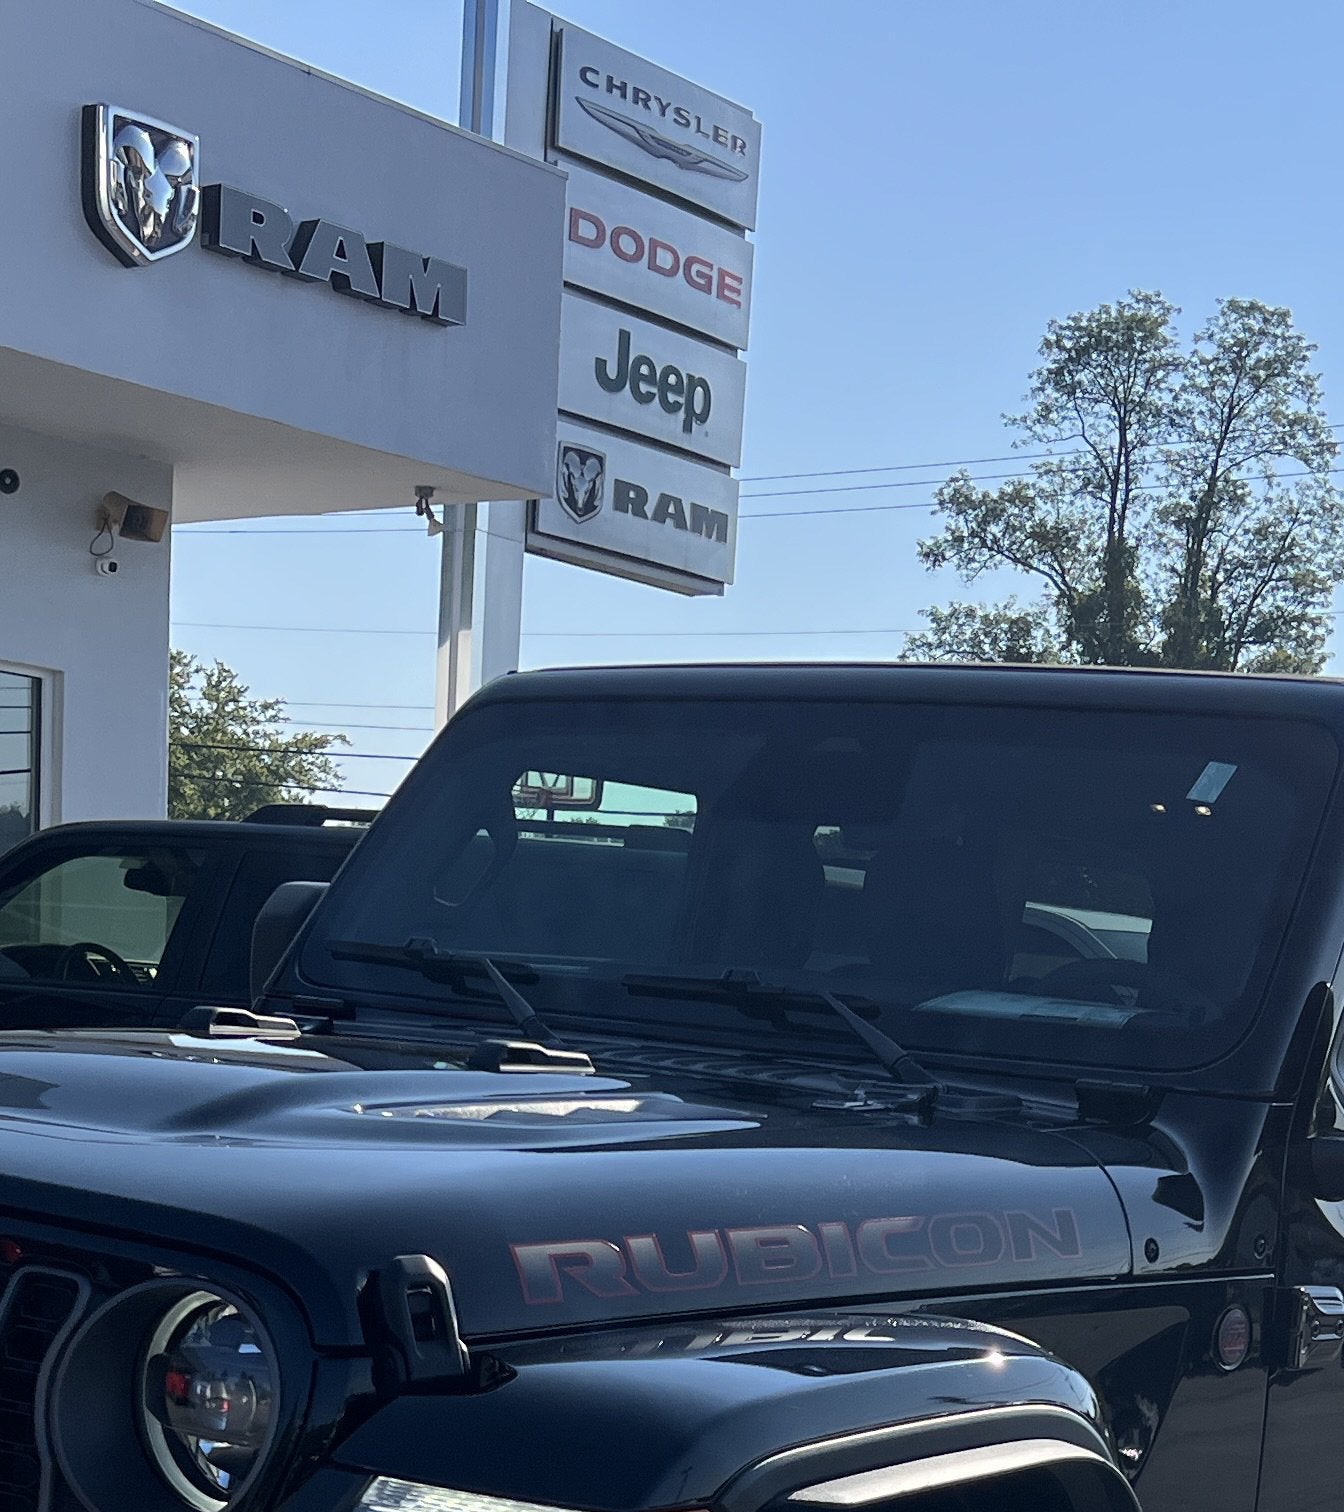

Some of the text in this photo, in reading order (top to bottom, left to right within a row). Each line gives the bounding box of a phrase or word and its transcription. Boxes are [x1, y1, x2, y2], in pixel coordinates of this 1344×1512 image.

[578, 64, 749, 158] CHRYSLER
[206, 183, 468, 327] RAM
[569, 206, 744, 309] DODGE
[594, 328, 713, 434] Jeep
[612, 477, 729, 545] RAM
[509, 1207, 1084, 1306] RUBICON
